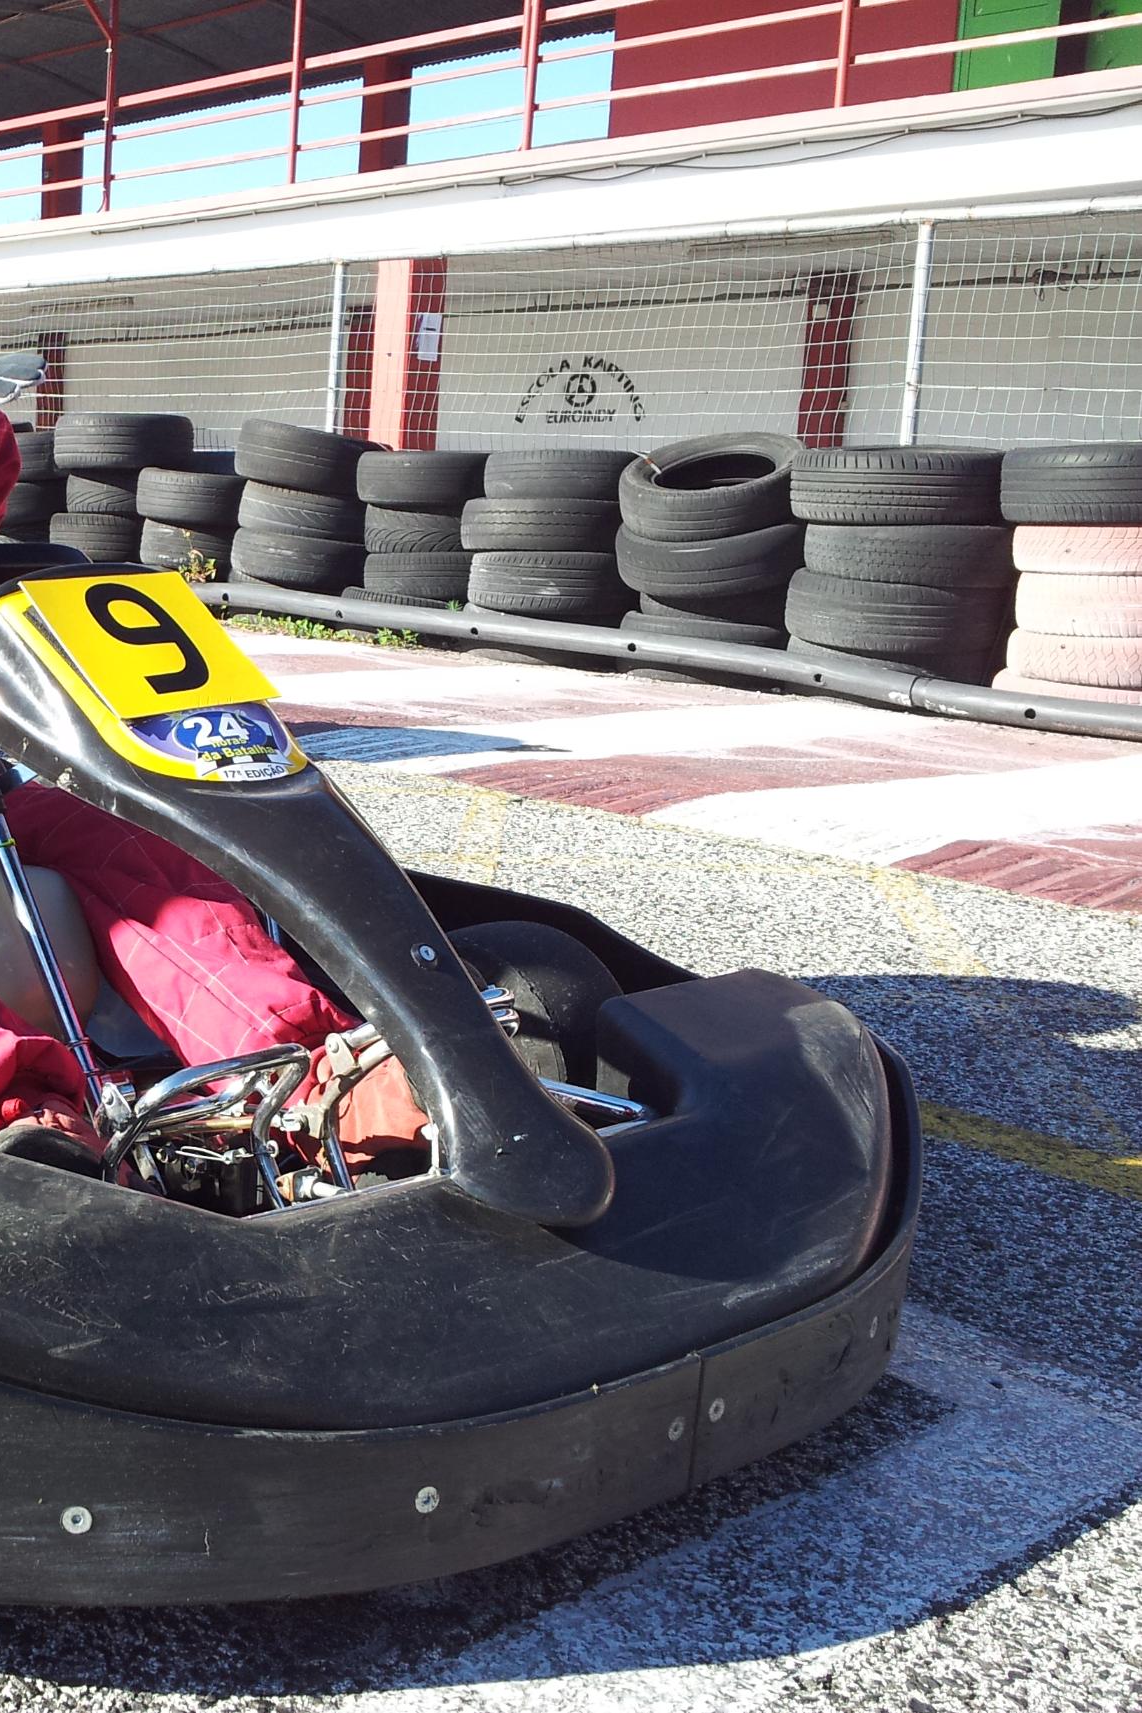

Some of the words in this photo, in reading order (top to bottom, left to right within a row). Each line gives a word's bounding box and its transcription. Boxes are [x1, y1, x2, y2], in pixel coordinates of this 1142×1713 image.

[514, 359, 571, 424] ESCOLA
[582, 355, 646, 422] KARTING
[84, 582, 209, 695] 9
[182, 712, 249, 747] 24
[201, 750, 220, 762] da
[222, 744, 276, 758] Batalha
[245, 764, 285, 779] EDIÇÃO
